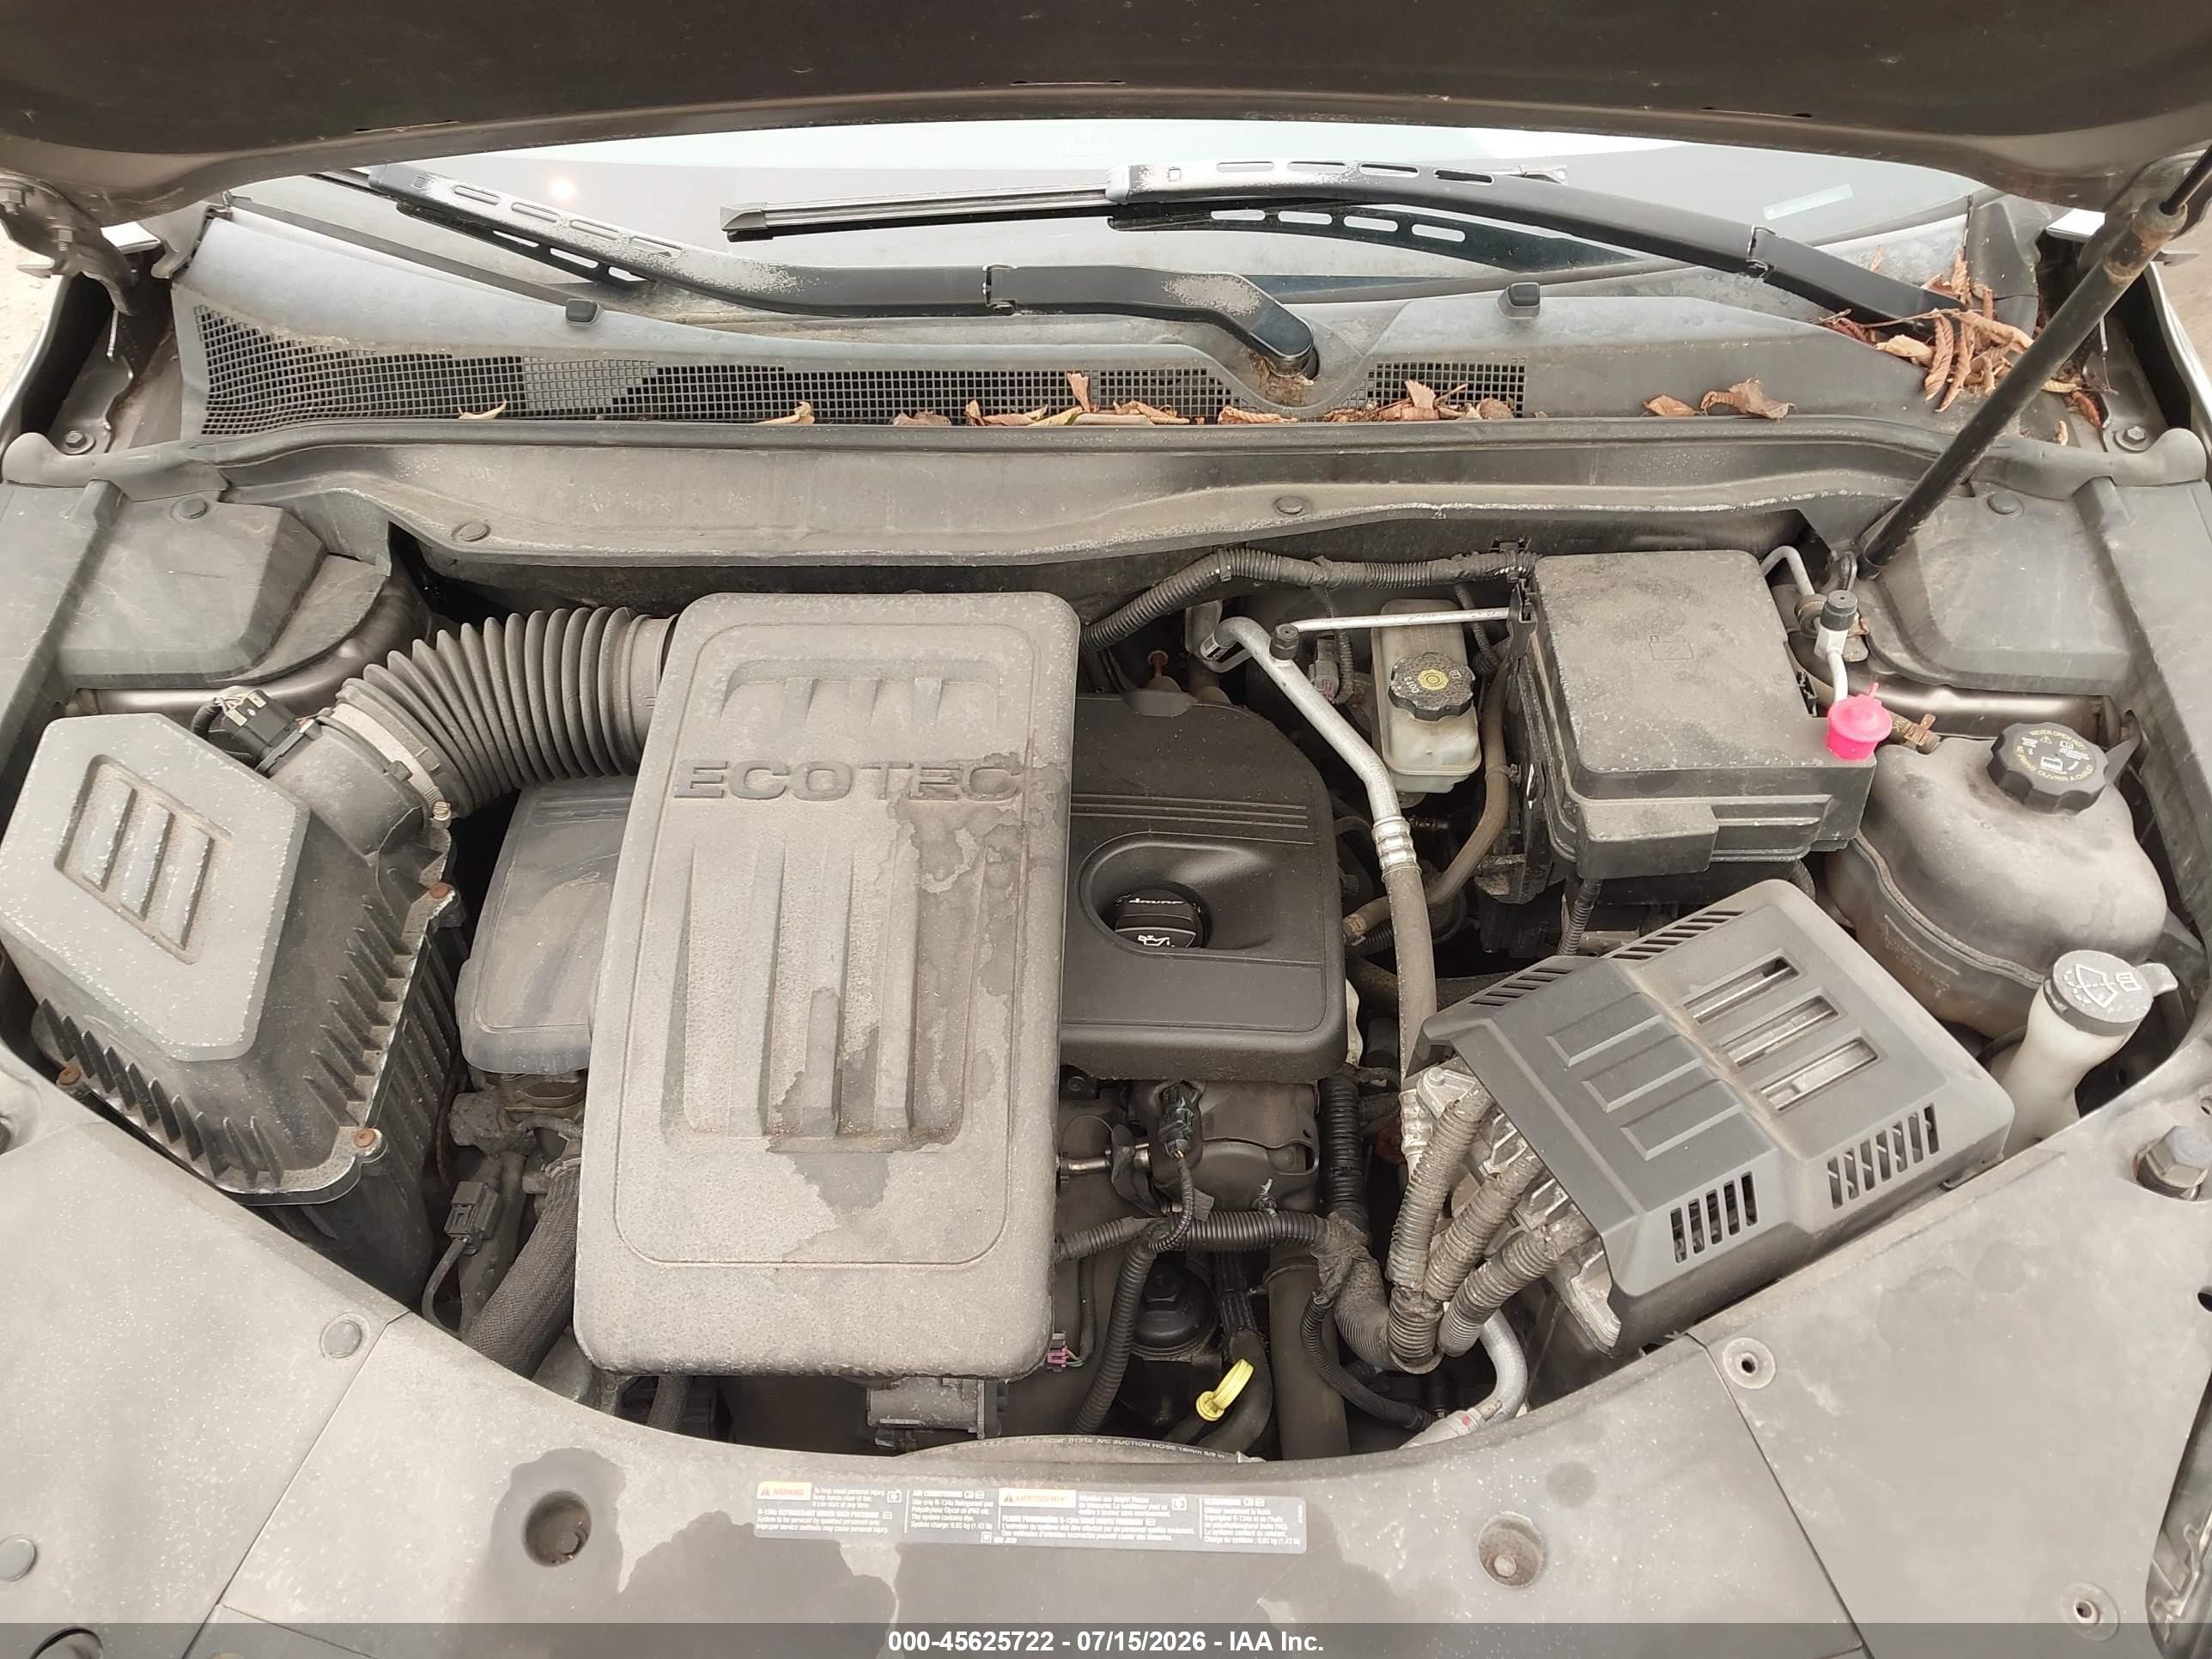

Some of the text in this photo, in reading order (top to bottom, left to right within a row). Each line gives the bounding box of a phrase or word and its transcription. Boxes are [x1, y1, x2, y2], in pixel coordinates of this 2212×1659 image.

[673, 760, 1023, 801] ECOTEC
[1113, 1439, 1151, 1448] SUCTION
[1152, 1443, 1176, 1451] HOSE
